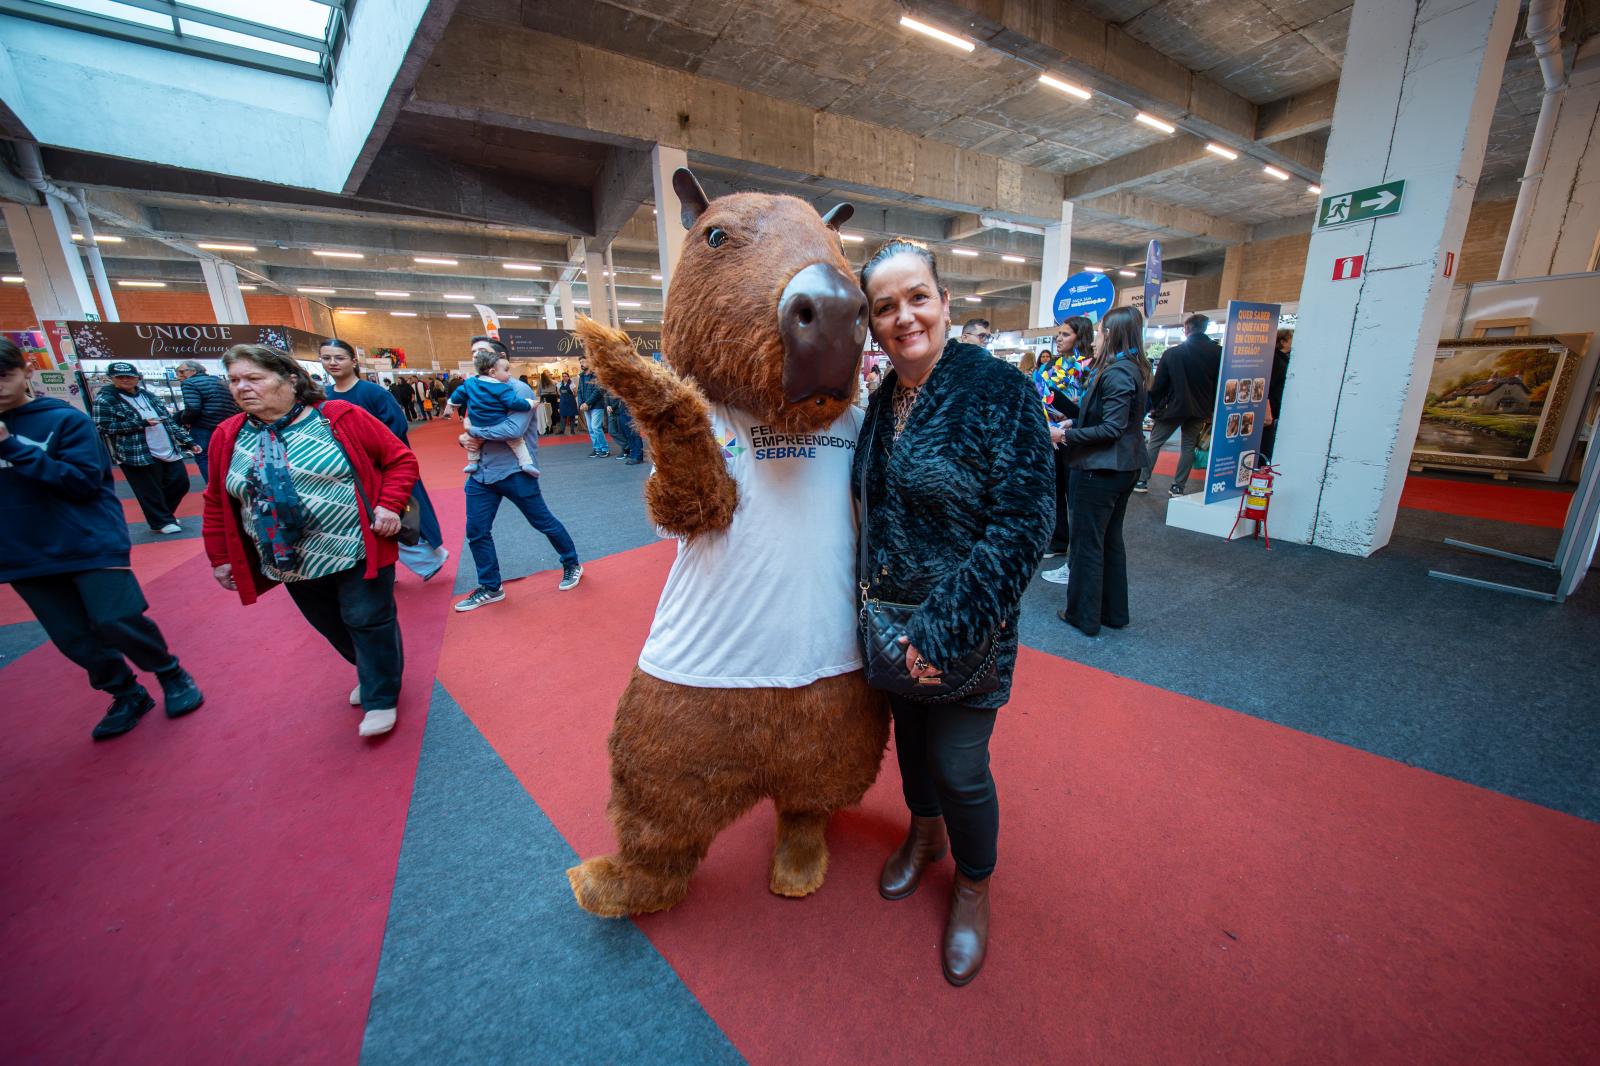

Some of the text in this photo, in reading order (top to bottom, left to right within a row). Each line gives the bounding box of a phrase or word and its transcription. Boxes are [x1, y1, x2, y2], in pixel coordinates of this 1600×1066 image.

[1238, 310, 1271, 321] QUER SABER
[135, 325, 232, 340] UNIQUE
[1242, 322, 1252, 333] QUE
[1252, 323, 1269, 332] FAZER
[1244, 334, 1268, 344] CURITIBA
[752, 434, 856, 450] EMPREENDEDOR
[755, 446, 816, 460] SEBRAE
[1211, 481, 1226, 494] RPC
